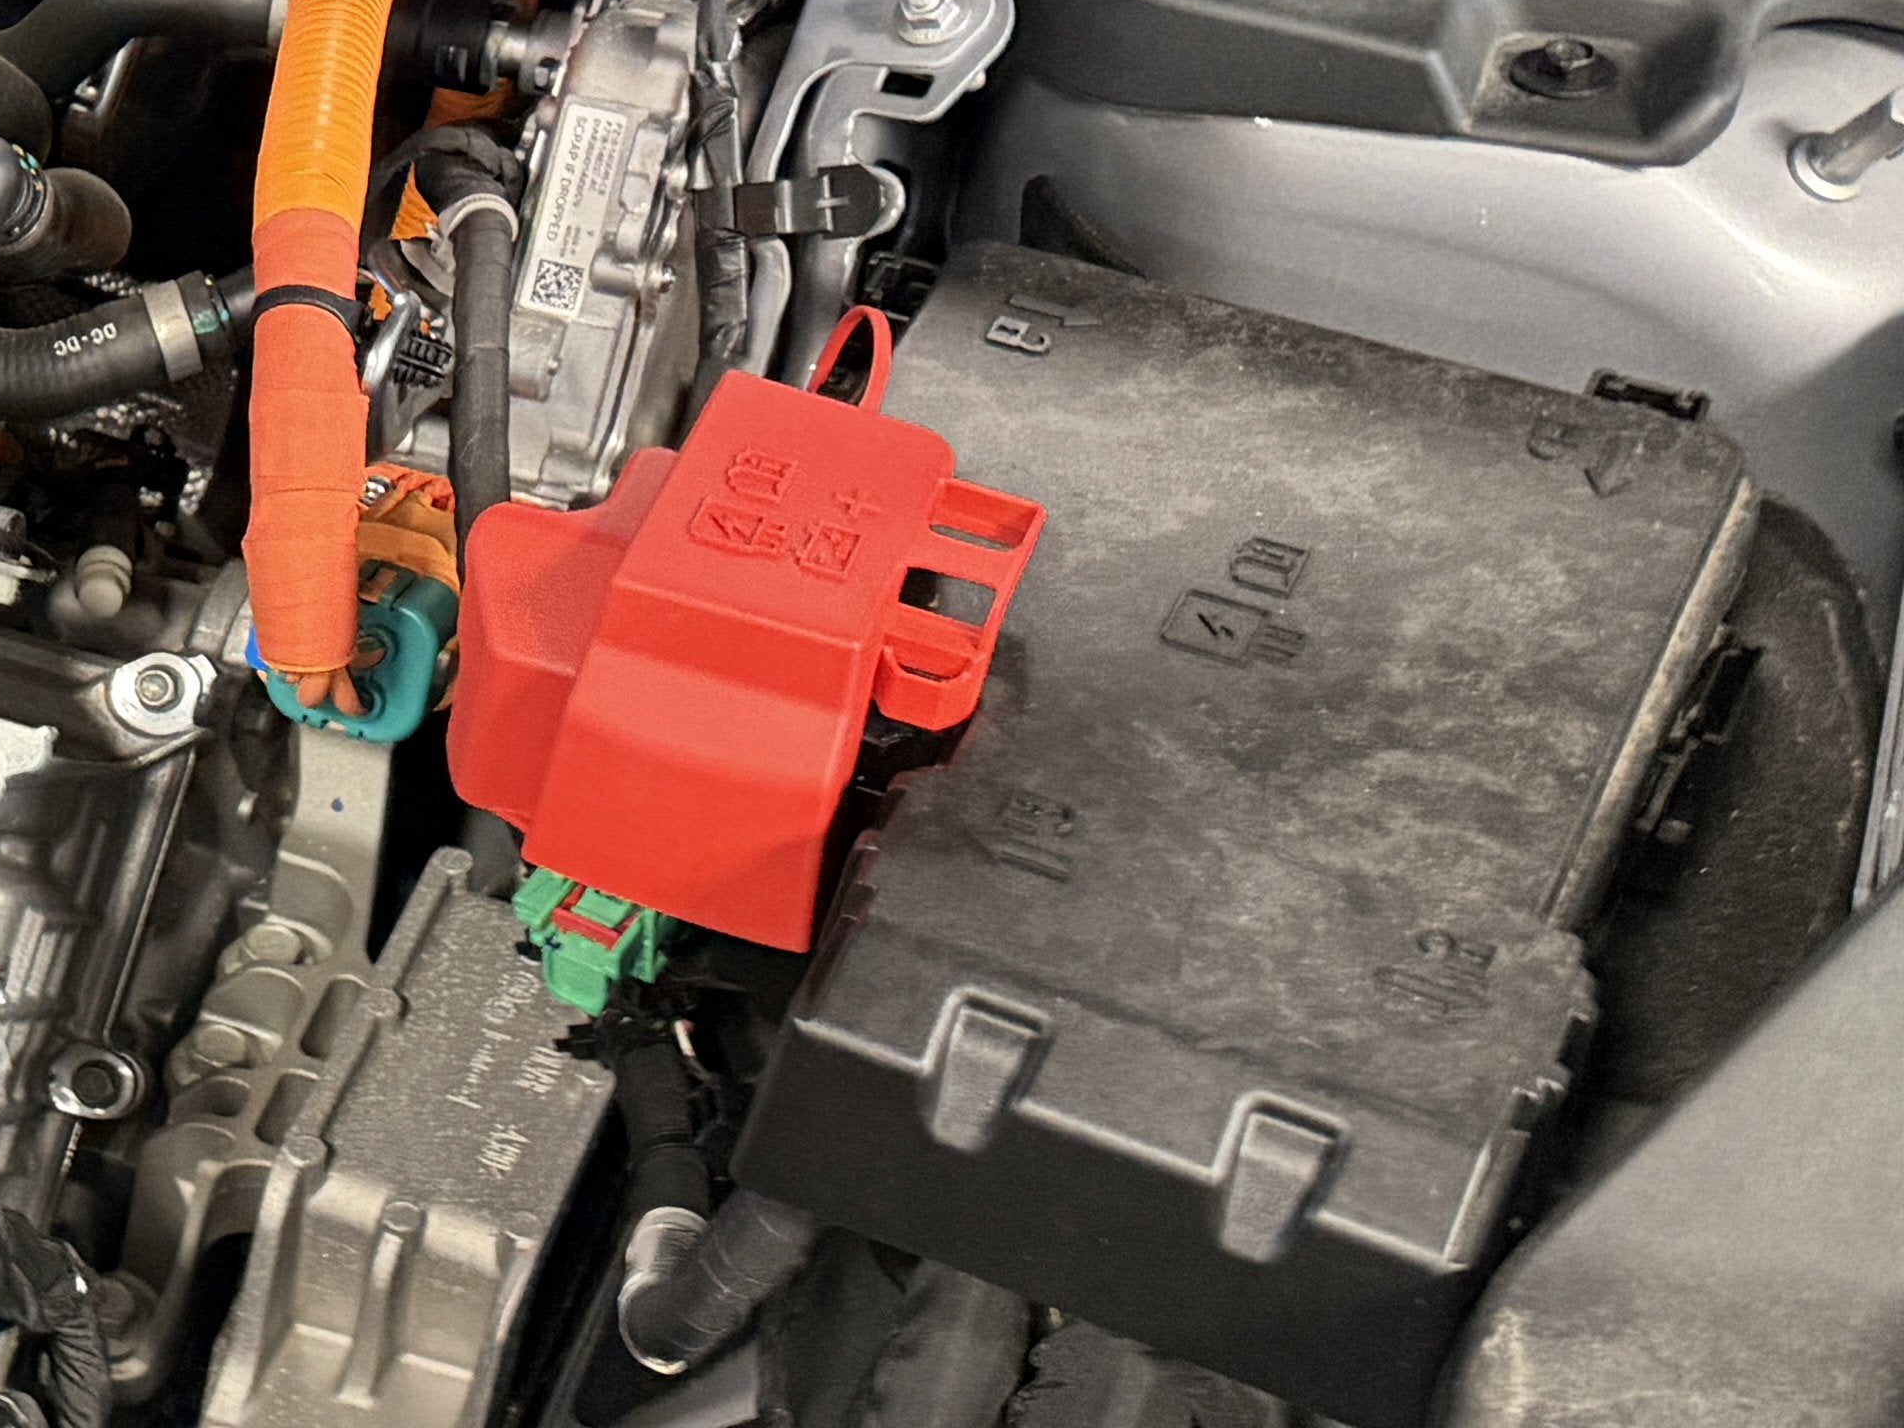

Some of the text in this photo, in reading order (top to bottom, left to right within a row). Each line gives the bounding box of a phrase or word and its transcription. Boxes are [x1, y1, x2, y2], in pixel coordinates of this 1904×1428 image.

[563, 114, 588, 162] SCRAP
[561, 161, 575, 176] IF
[543, 175, 573, 243] DROPPED
